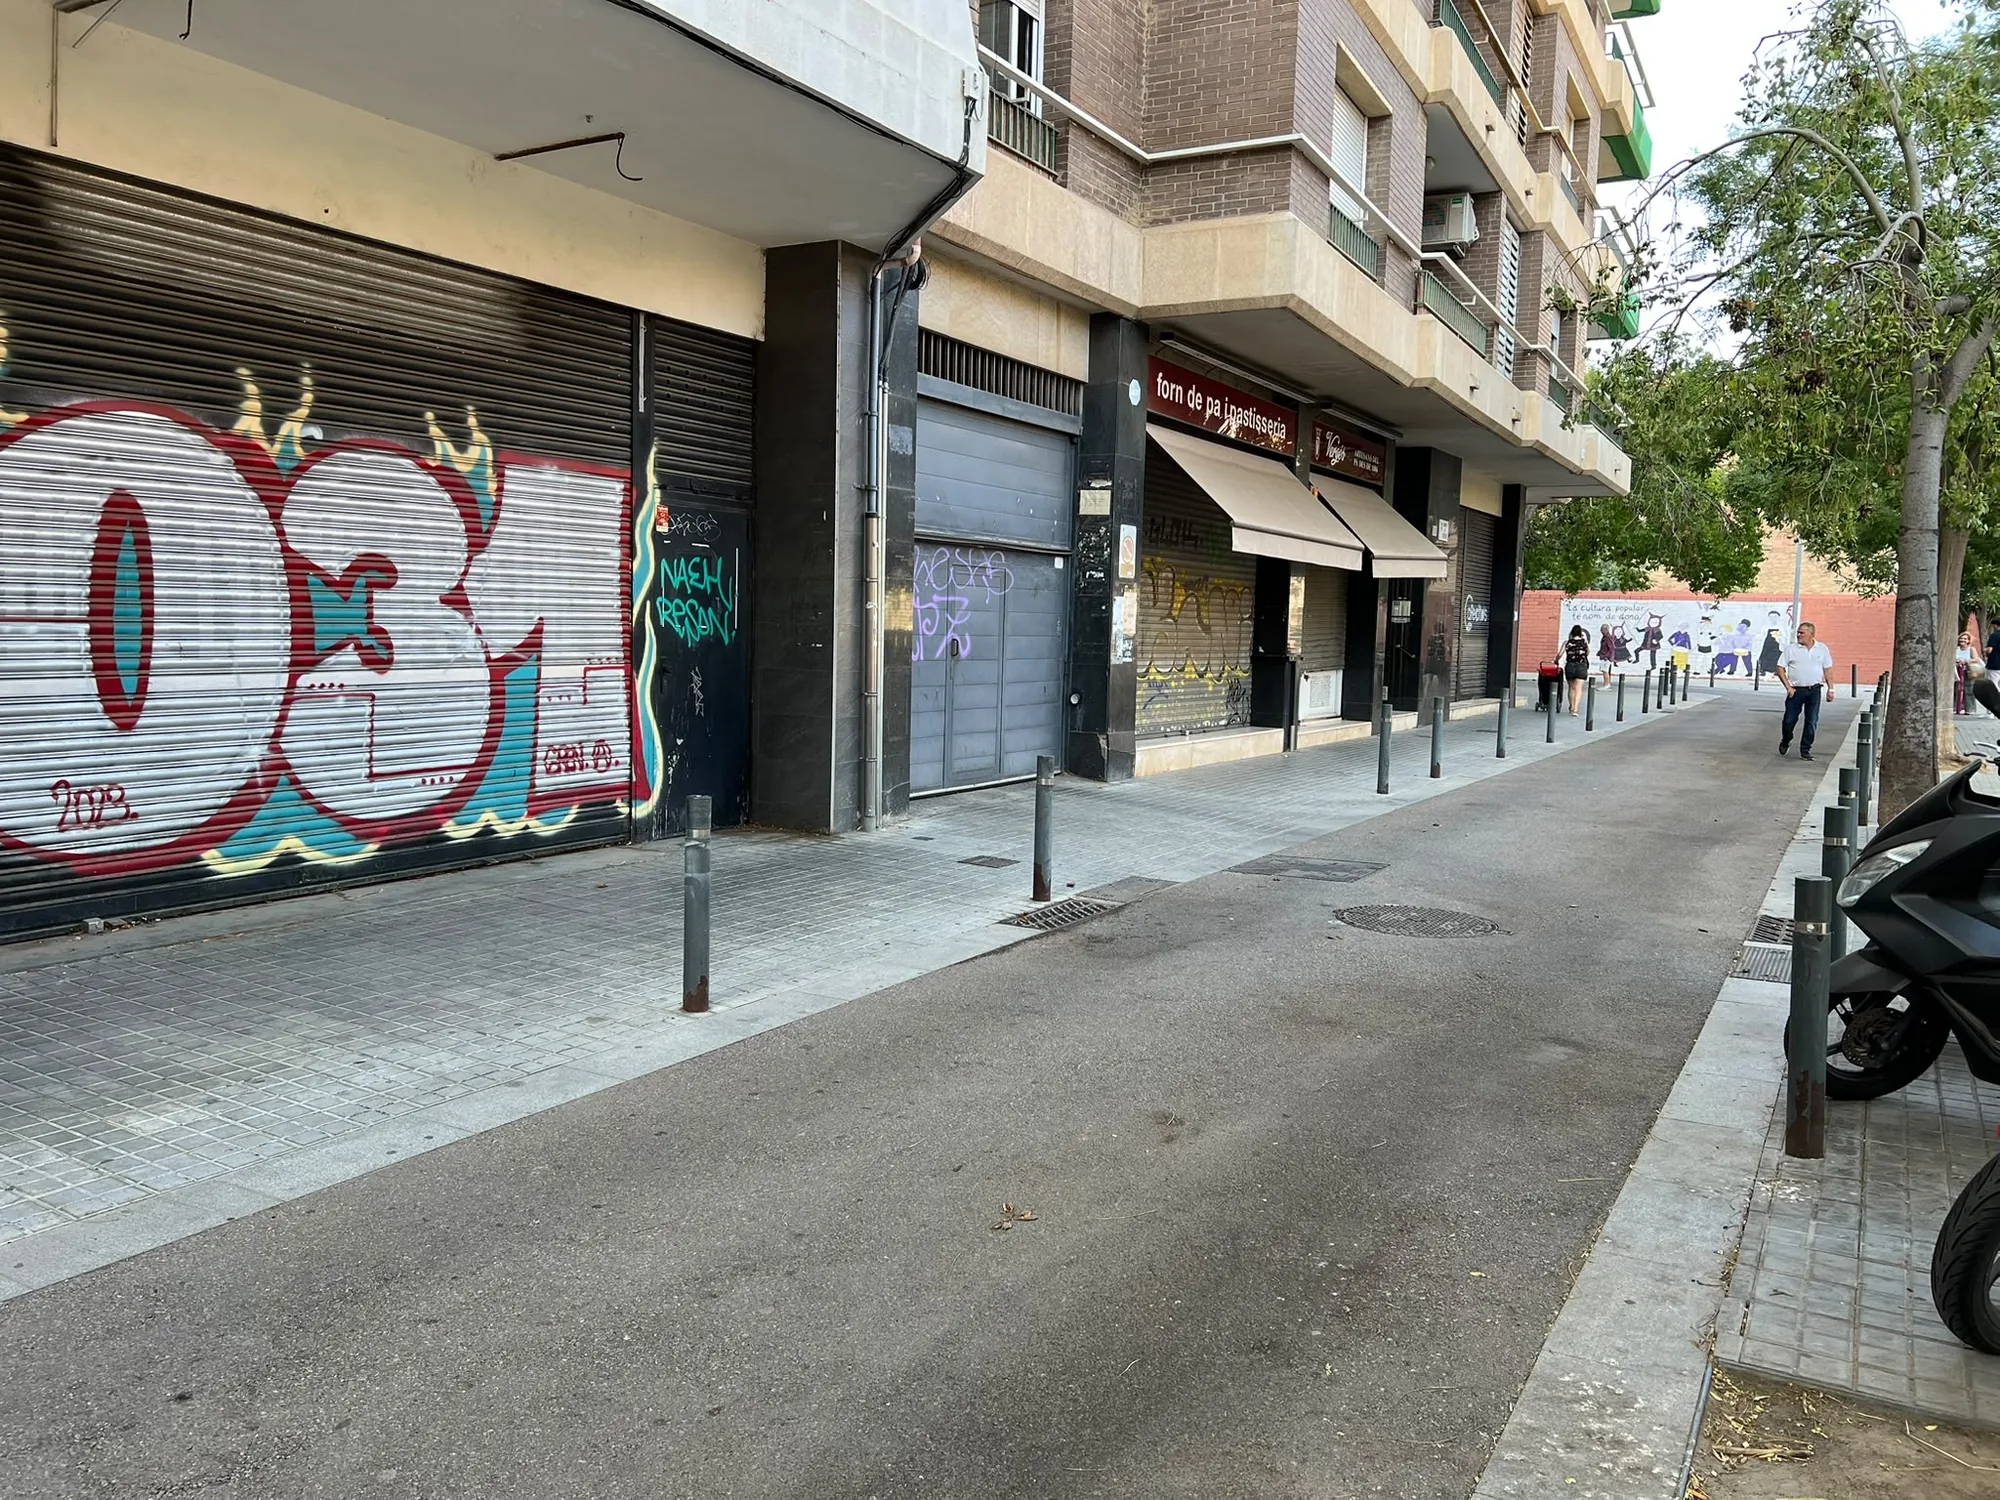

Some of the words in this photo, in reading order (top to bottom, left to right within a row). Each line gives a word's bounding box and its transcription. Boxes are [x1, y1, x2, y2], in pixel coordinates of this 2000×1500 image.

[1156, 372, 1183, 405] forn
[1187, 384, 1203, 411] de
[1206, 395, 1221, 420] pa
[1224, 396, 1229, 420] i
[1230, 403, 1287, 440] pastisseria
[1580, 603, 1612, 612] cultura
[1615, 603, 1645, 612] popular
[1618, 613, 1641, 621] dona
